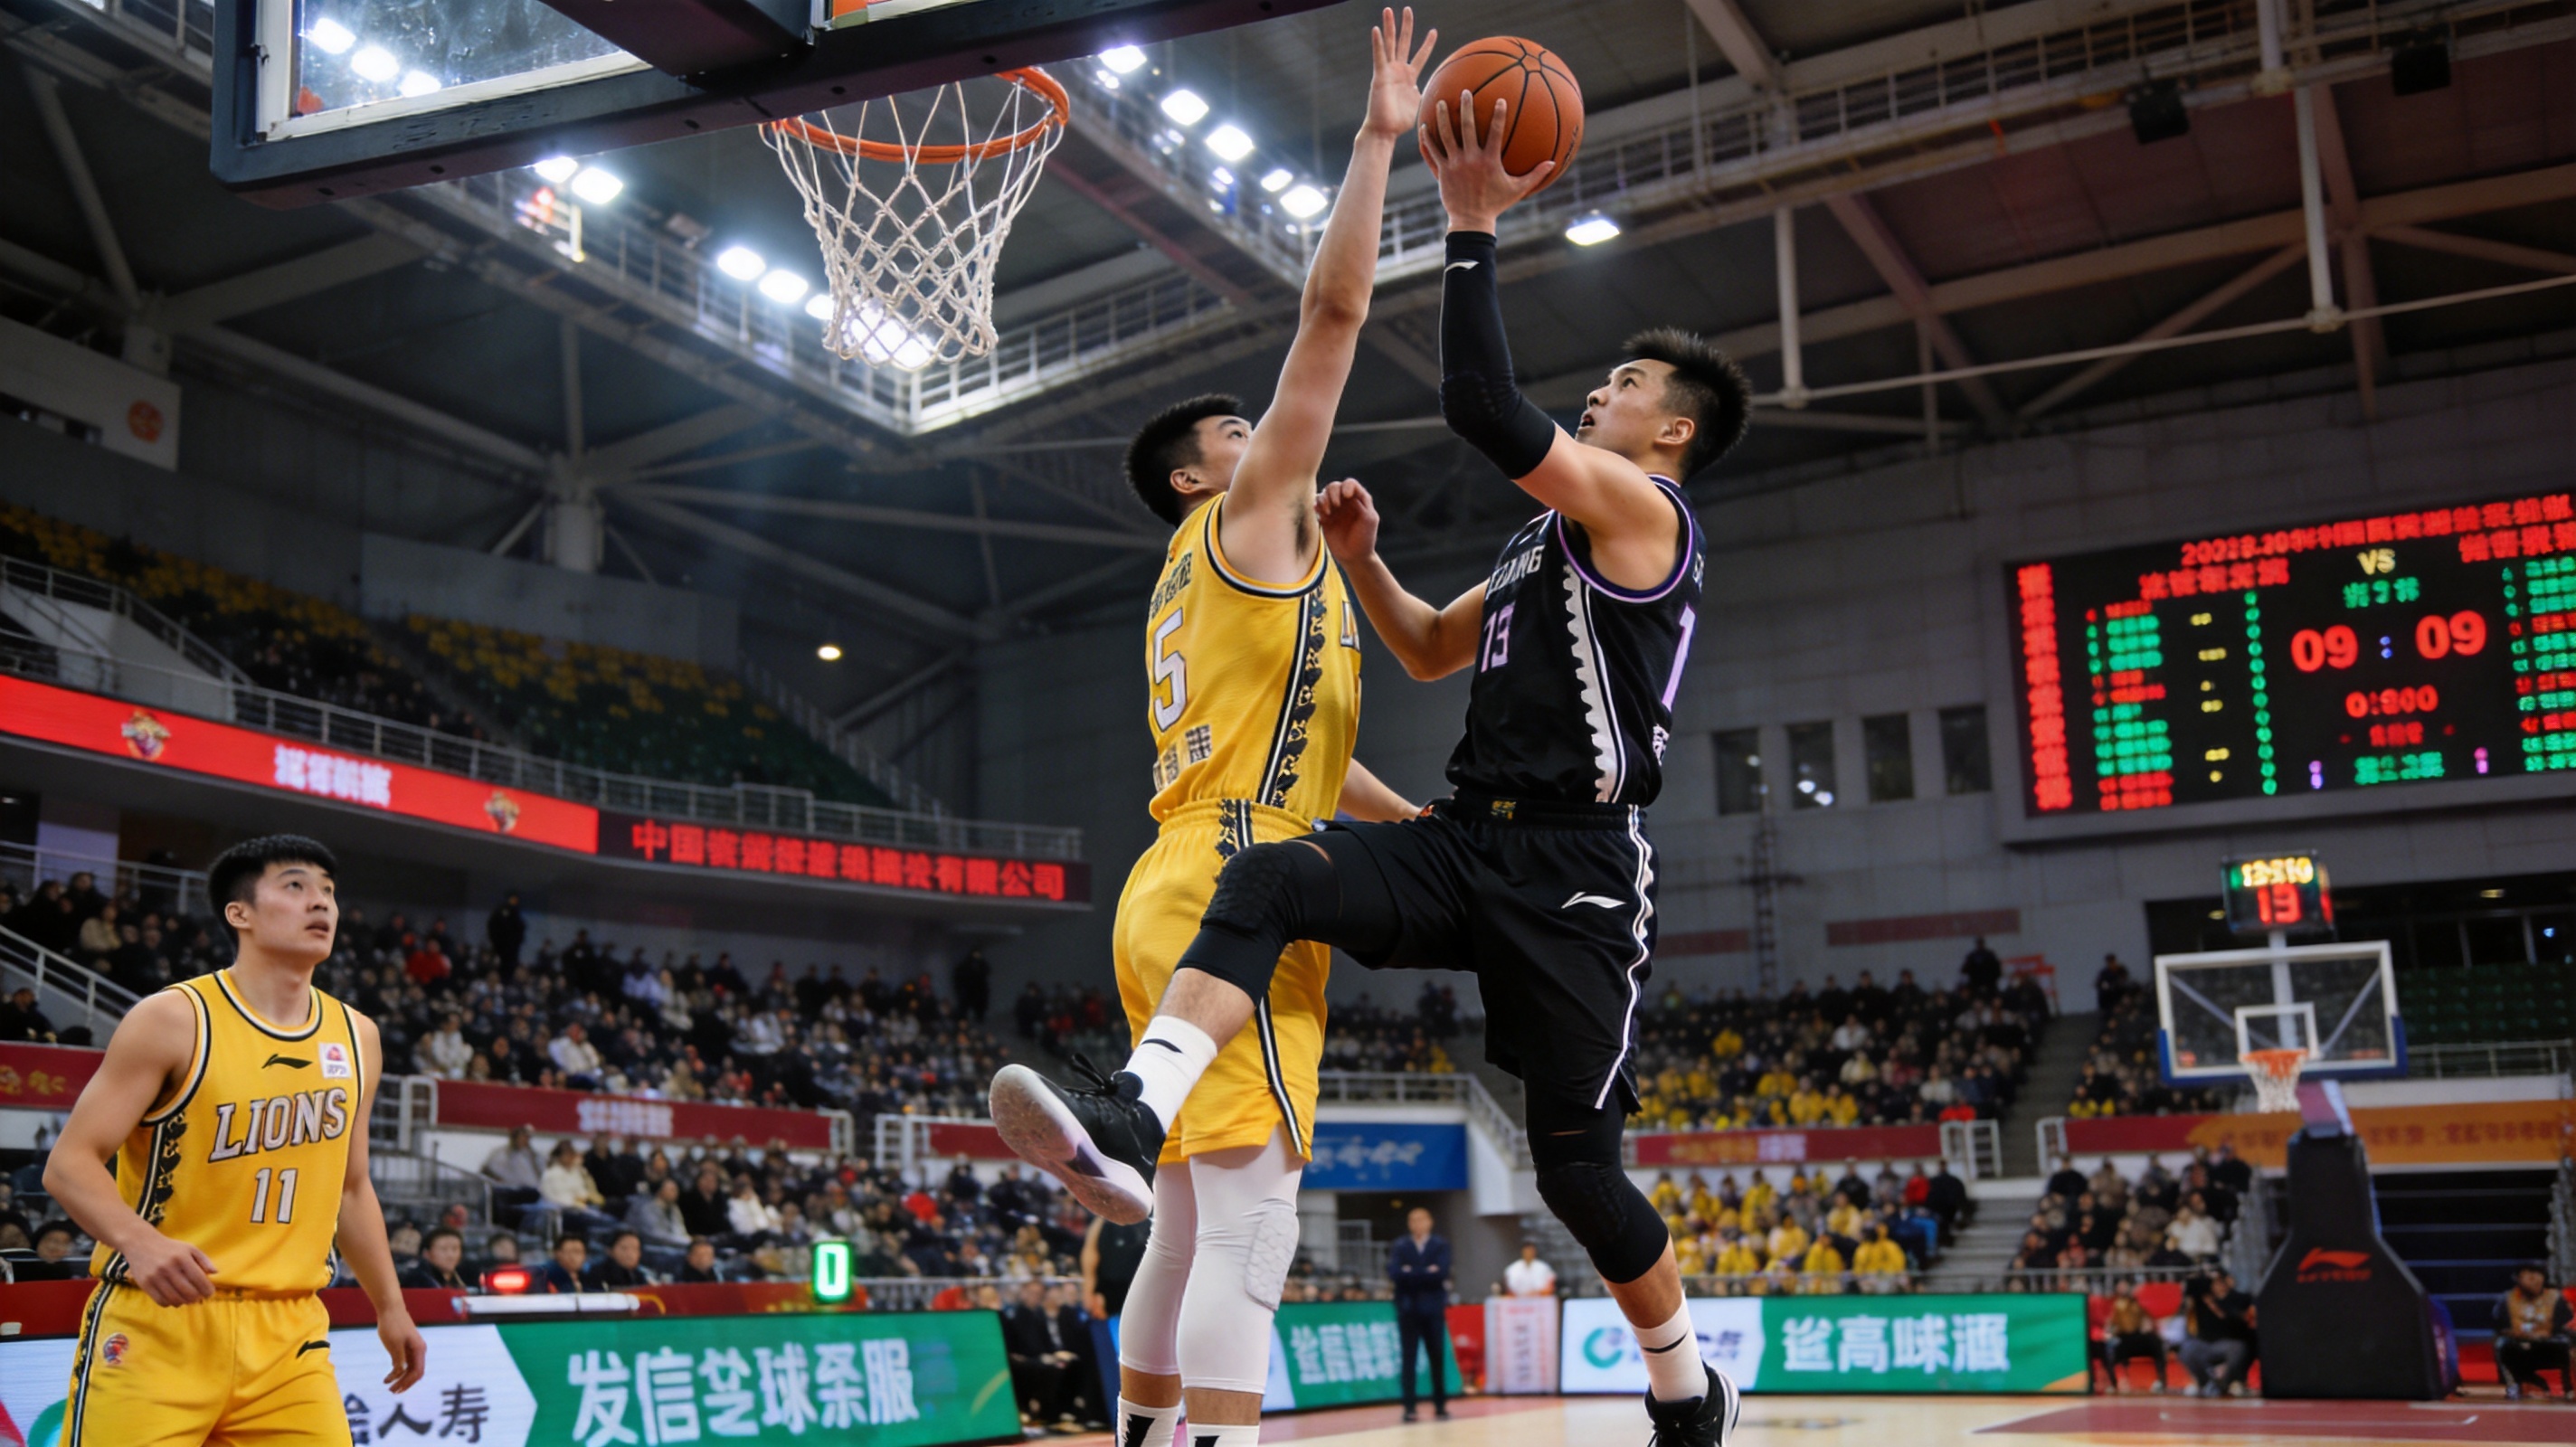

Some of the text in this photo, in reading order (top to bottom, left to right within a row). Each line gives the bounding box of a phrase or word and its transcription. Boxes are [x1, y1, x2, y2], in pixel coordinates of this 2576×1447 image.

[2356, 548, 2396, 575] VS
[1153, 607, 1188, 733] 5
[208, 1087, 347, 1163] LIONS
[250, 1168, 298, 1225] 11
